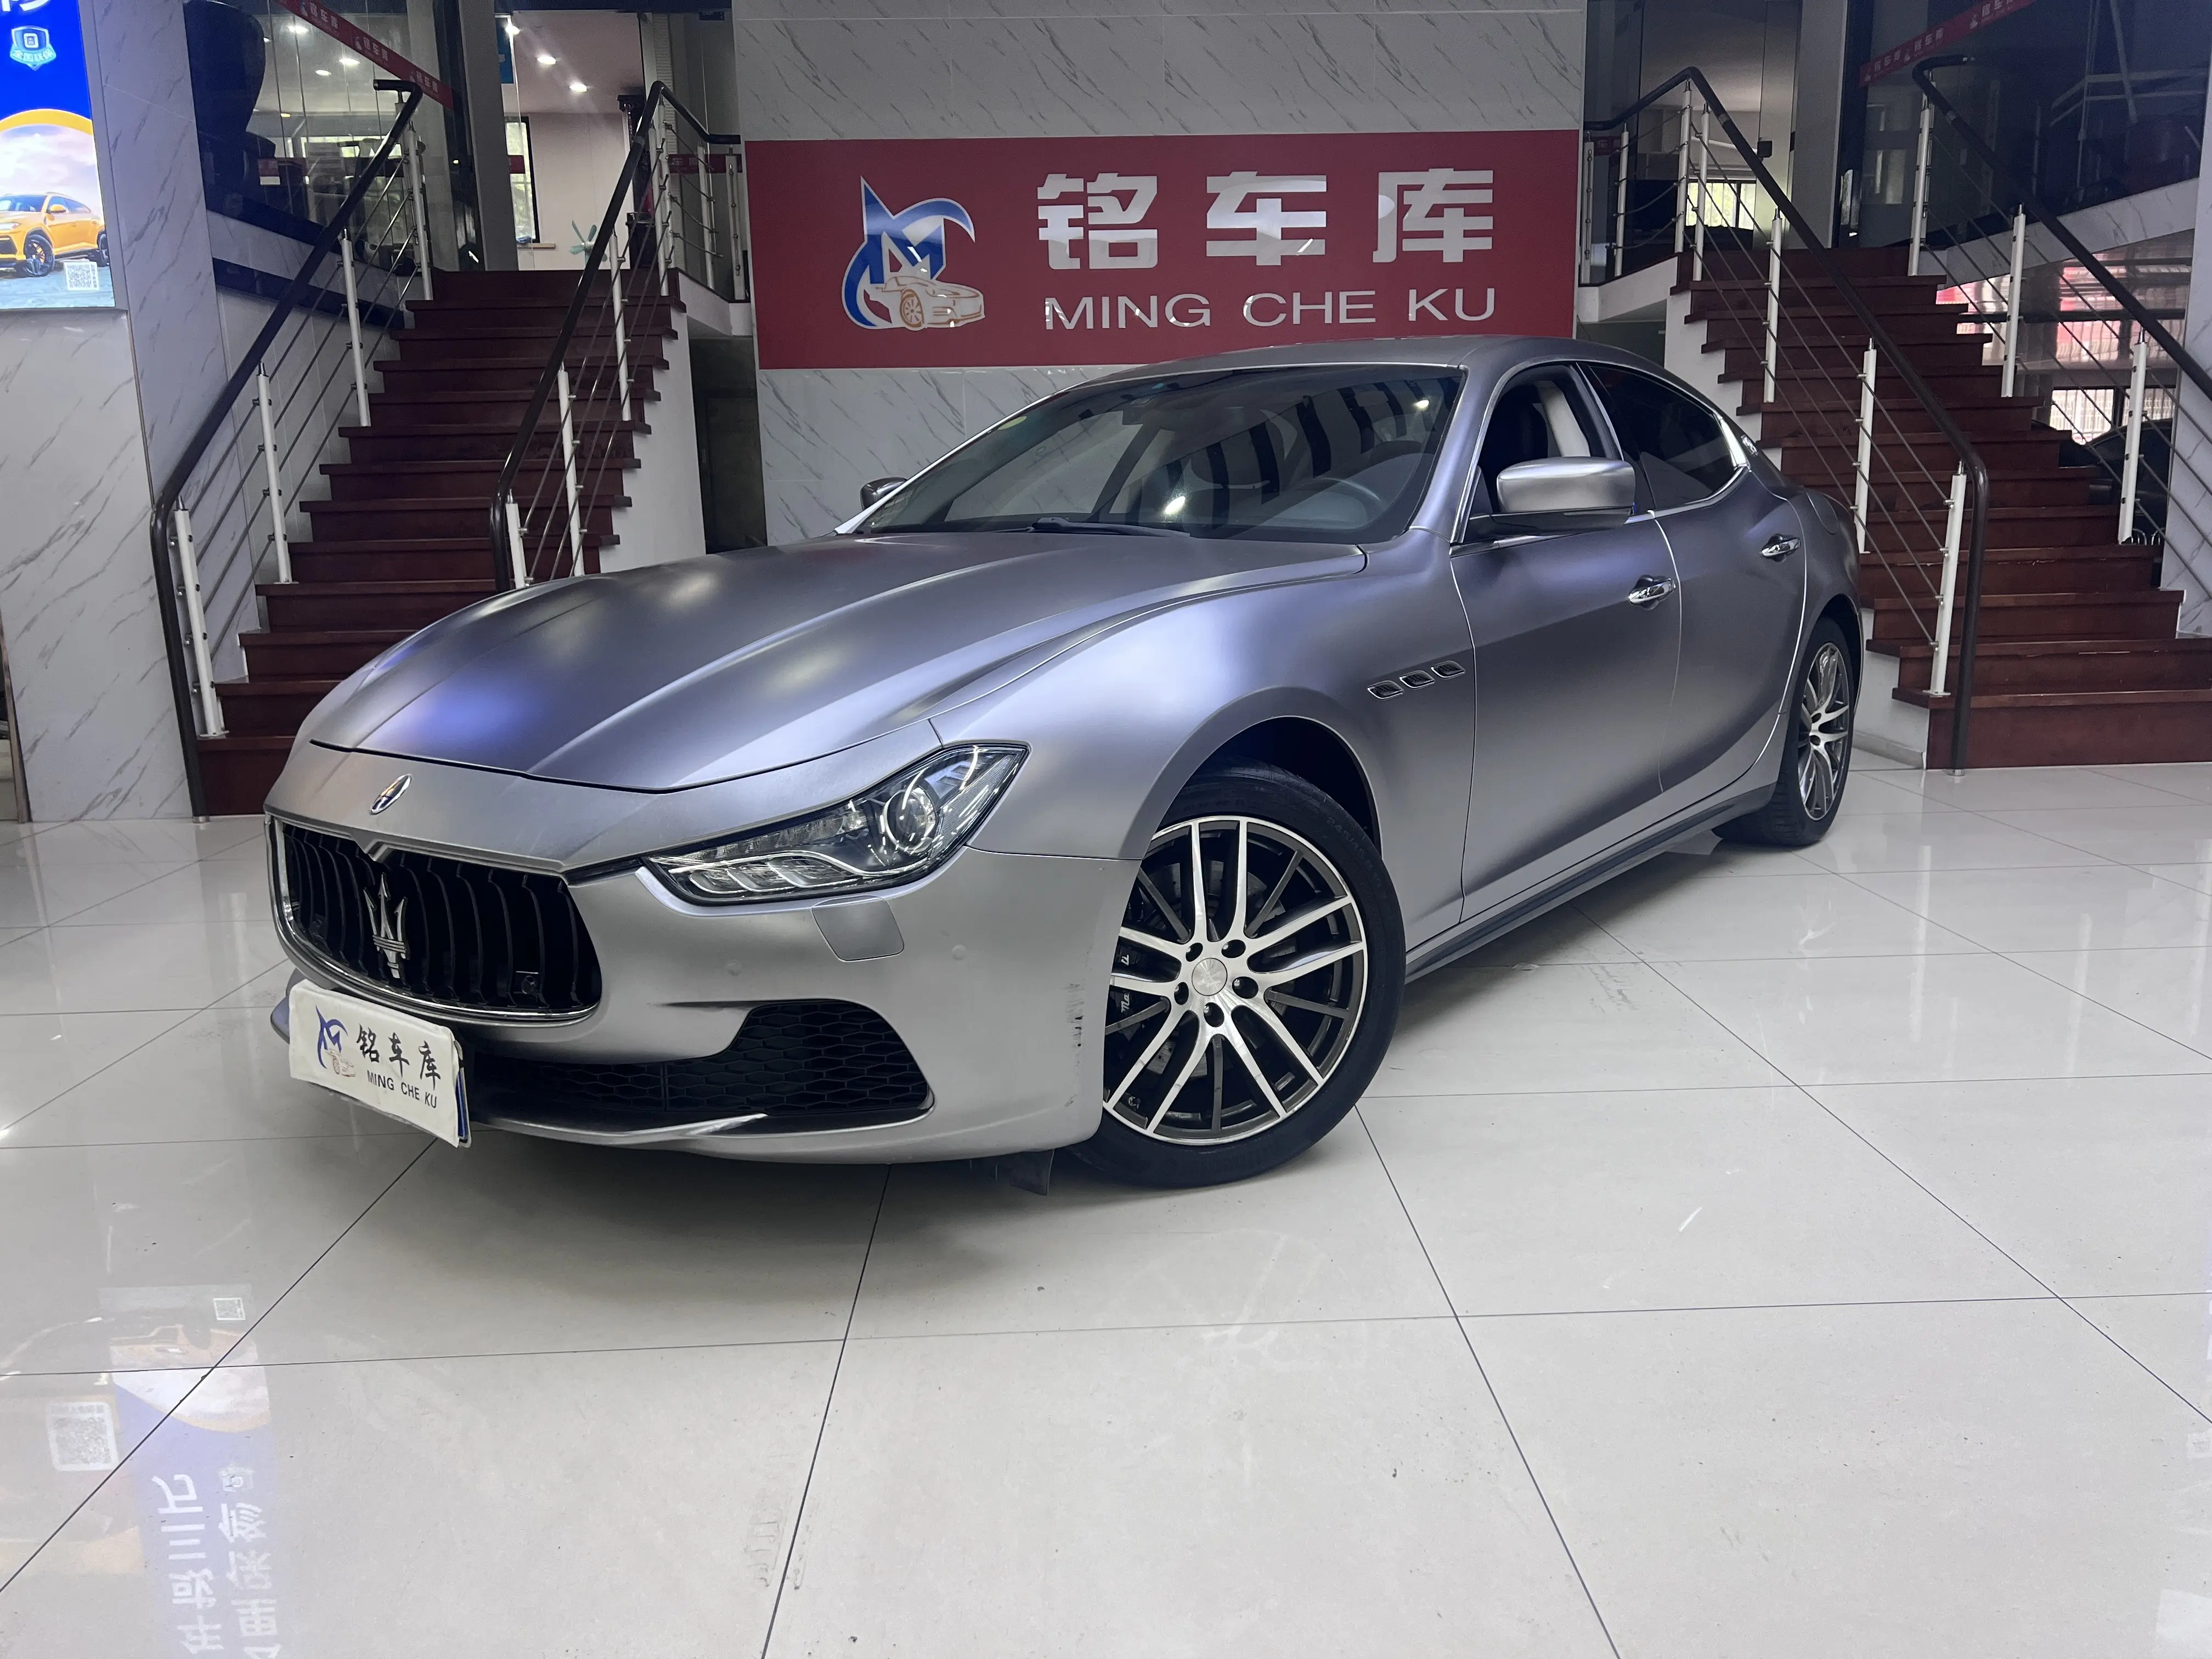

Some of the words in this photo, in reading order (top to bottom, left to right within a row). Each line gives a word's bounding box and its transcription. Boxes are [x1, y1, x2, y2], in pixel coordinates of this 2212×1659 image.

[1037, 168, 1493, 270] 铭车库
[1045, 293, 1211, 330] MING
[1243, 290, 1376, 327] CHE
[1408, 287, 1495, 322] KU
[357, 1023, 441, 1091] 铭车库
[366, 1070, 394, 1091] MING
[400, 1082, 420, 1101] CHE
[425, 1092, 437, 1109] KU
